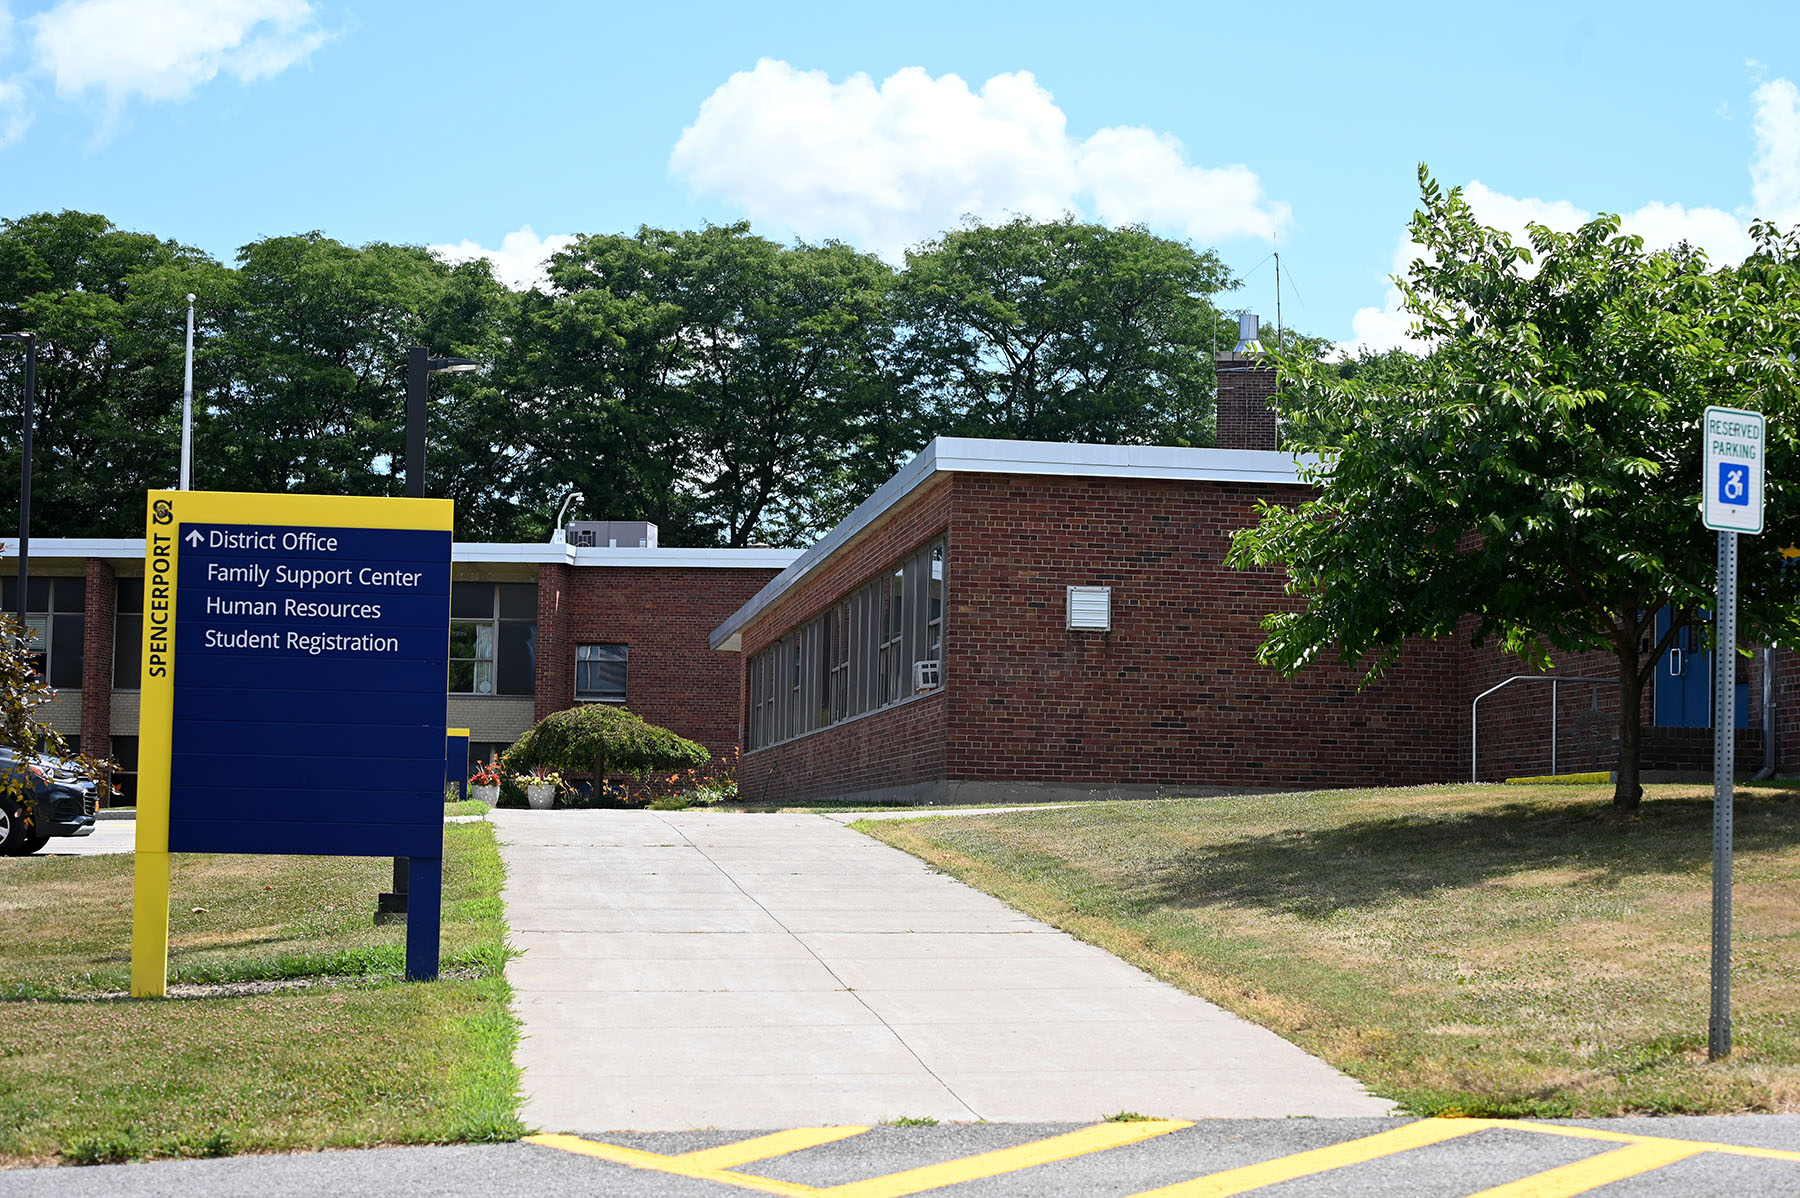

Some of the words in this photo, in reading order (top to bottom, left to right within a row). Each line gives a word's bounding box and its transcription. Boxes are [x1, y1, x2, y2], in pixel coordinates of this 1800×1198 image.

[1710, 420, 1759, 440] RESERVED
[1713, 441, 1756, 460] PARKING
[209, 530, 276, 549] District
[282, 532, 338, 551] Office
[207, 563, 270, 587] Family
[275, 565, 352, 589] Support
[358, 568, 422, 587] Center
[149, 531, 172, 678] SPENCERPORT
[206, 596, 277, 616] Human
[284, 599, 381, 619] Resources
[205, 629, 280, 649] Student
[286, 632, 398, 655] Registration
